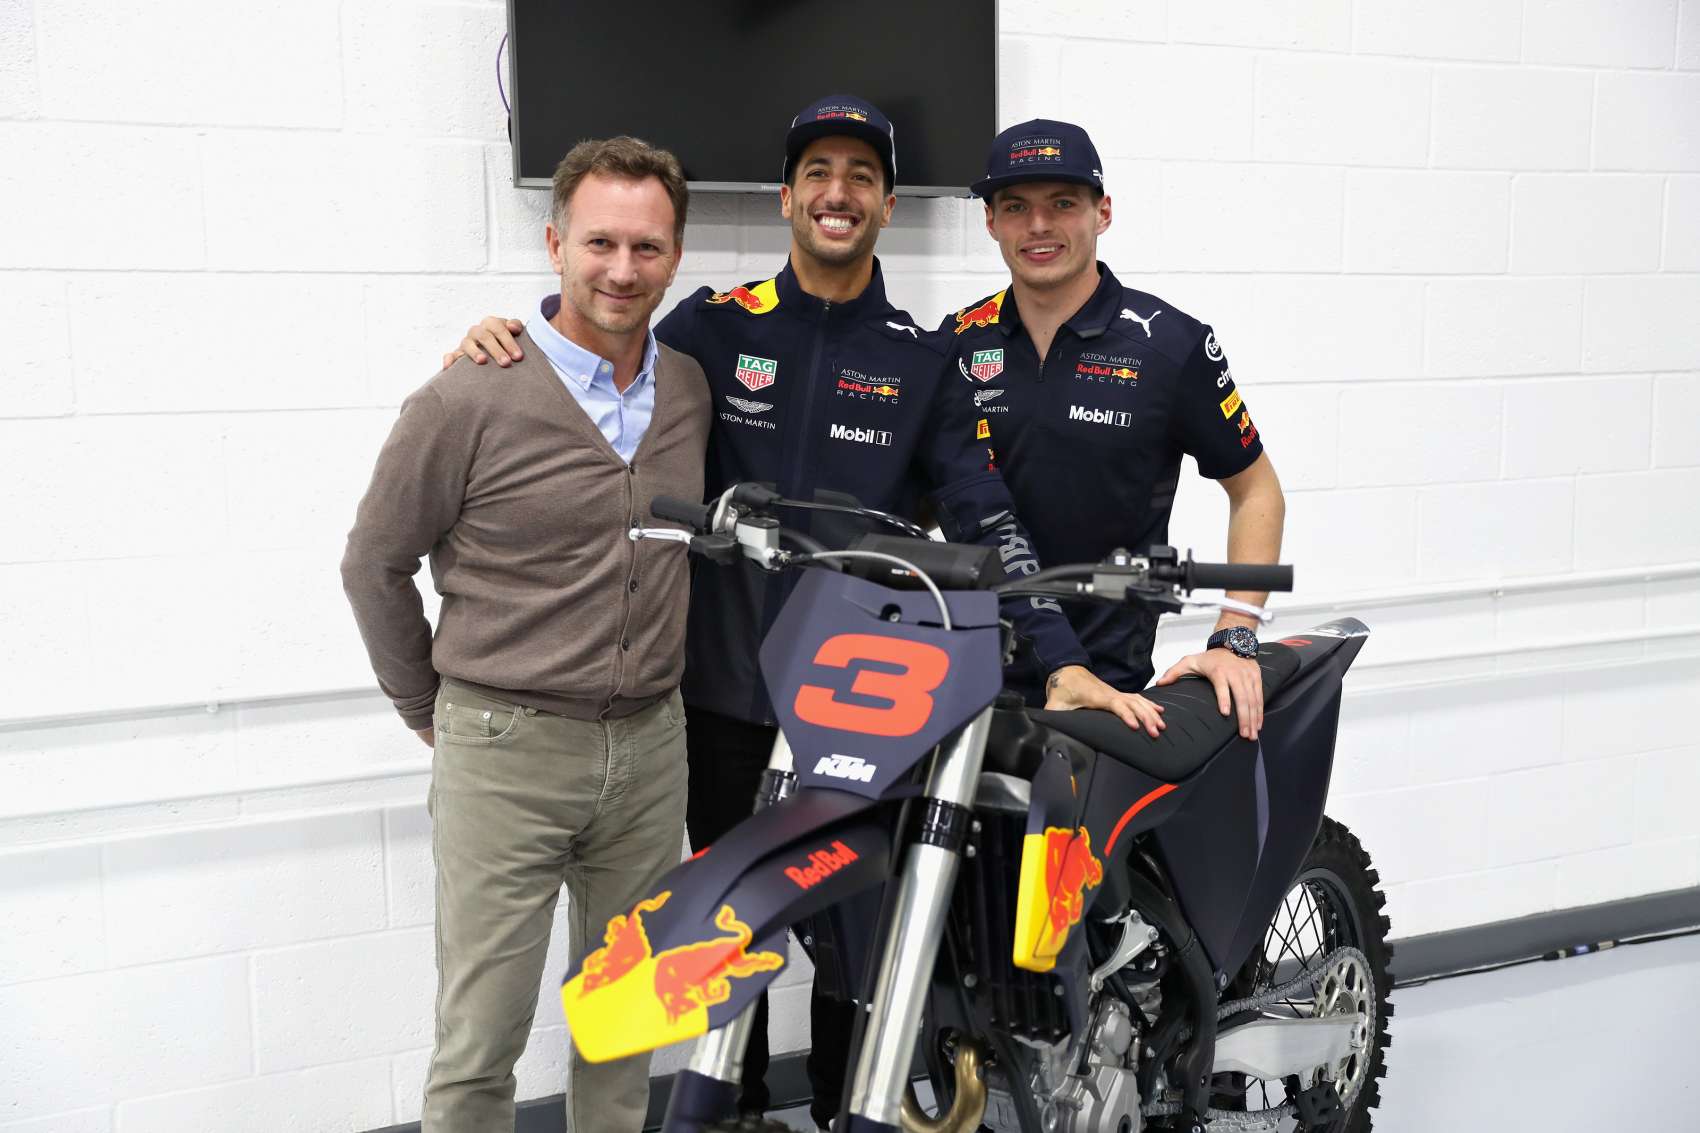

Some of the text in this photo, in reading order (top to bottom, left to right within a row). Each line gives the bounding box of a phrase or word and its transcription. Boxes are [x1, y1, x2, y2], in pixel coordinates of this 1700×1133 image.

[1011, 139, 1031, 148] ASTON
[1010, 156, 1061, 165] RACING
[741, 356, 773, 373] TAG
[976, 352, 1001, 363] TAG
[1080, 352, 1142, 366] ASTON MARTIN
[738, 369, 772, 389] HEUER
[841, 368, 901, 384] ASTON MARTIN
[972, 363, 1002, 380] HEUER
[1075, 374, 1137, 387] RACING
[836, 389, 898, 404] RACING
[1069, 405, 1114, 425] Mobil
[744, 418, 776, 430] MARTIN
[830, 423, 874, 444] Mobil
[793, 633, 949, 737] 3
[813, 754, 877, 783] KTM
